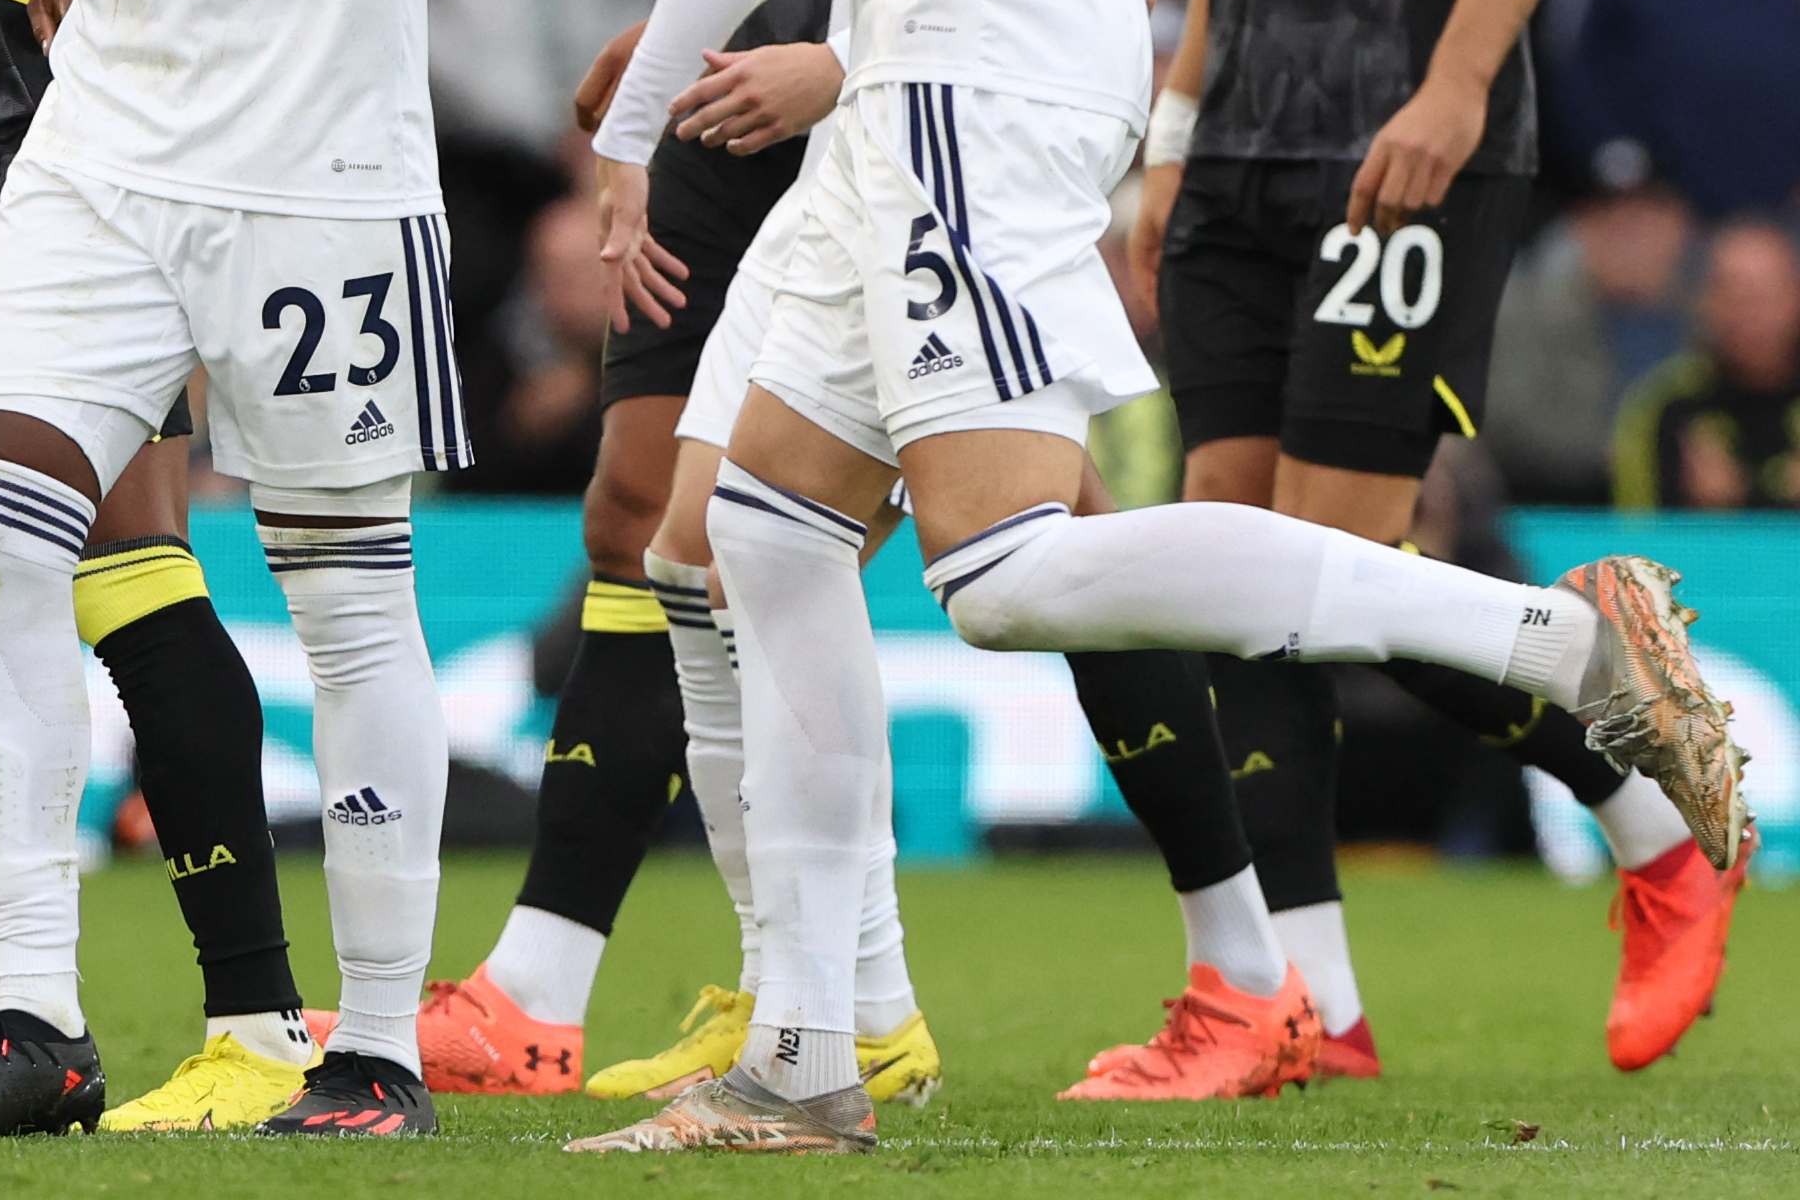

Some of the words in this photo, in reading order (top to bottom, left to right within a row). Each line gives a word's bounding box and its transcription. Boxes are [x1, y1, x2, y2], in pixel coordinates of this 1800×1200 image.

[905, 212, 957, 321] 5
[1313, 222, 1443, 329] 20
[262, 272, 400, 396] 23
[907, 354, 964, 380] adidas
[345, 422, 395, 446] adidas
[327, 808, 403, 827] adidas
[166, 843, 237, 881] ILLA
